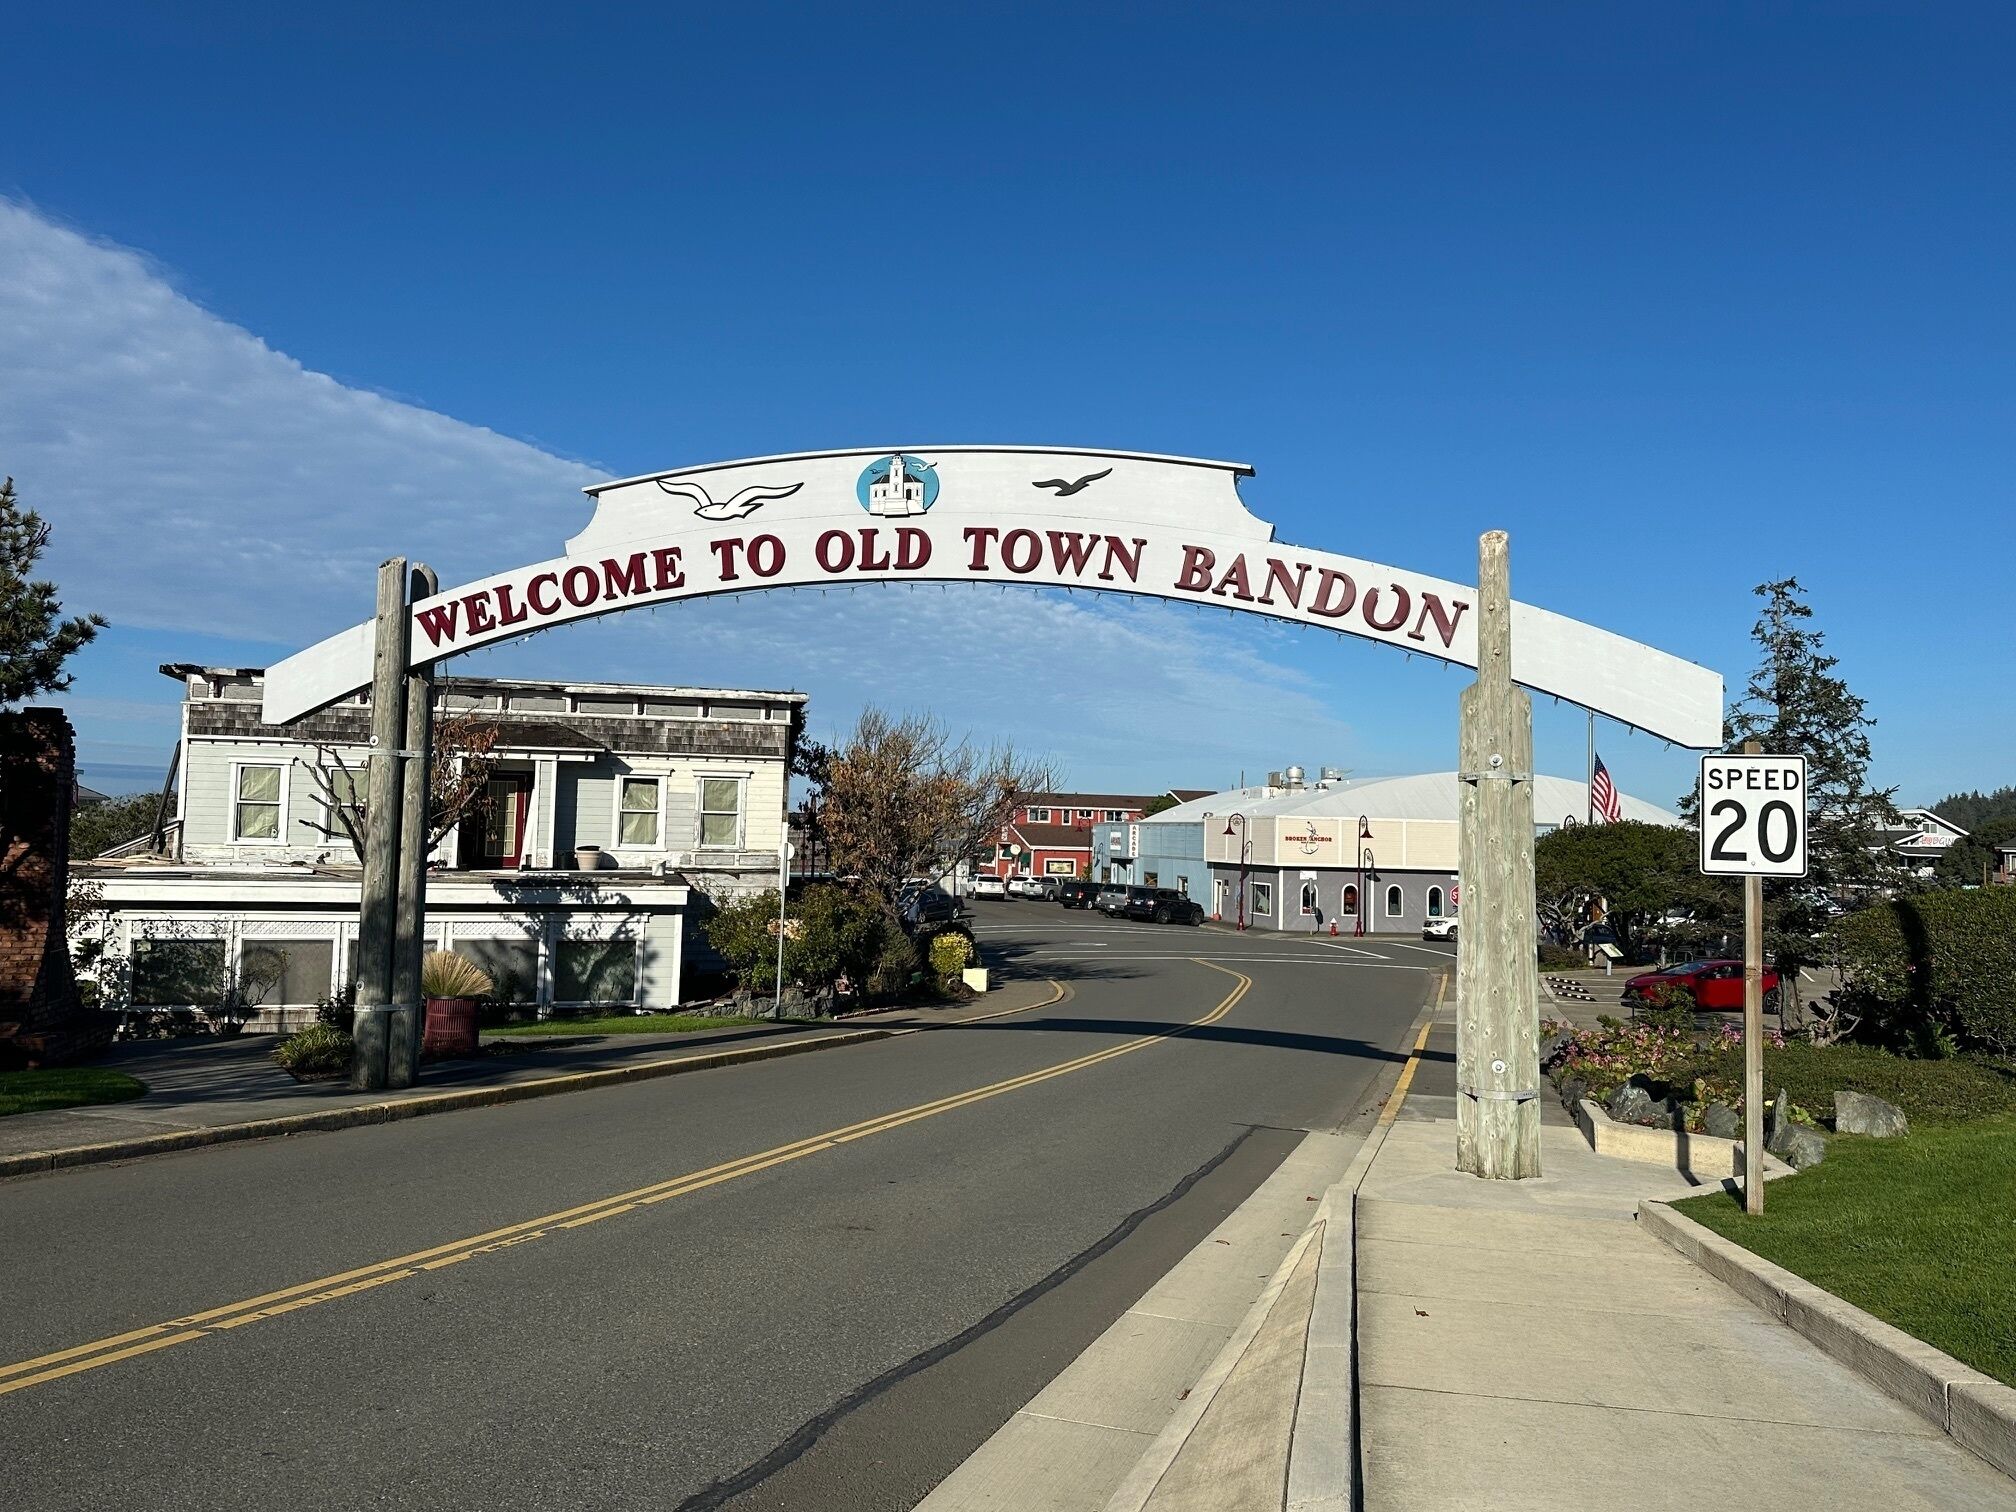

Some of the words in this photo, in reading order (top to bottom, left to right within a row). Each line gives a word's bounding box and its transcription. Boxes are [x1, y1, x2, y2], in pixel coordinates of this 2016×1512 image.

[414, 546, 686, 648] WELCOME
[710, 533, 787, 581] TO
[815, 527, 933, 573] OLD
[963, 527, 1148, 583] TOWN
[1173, 544, 1470, 649] BANDON
[1708, 768, 1800, 791] SPEED
[1710, 799, 1798, 864] 20
[1921, 836, 1955, 846] LODGIN
